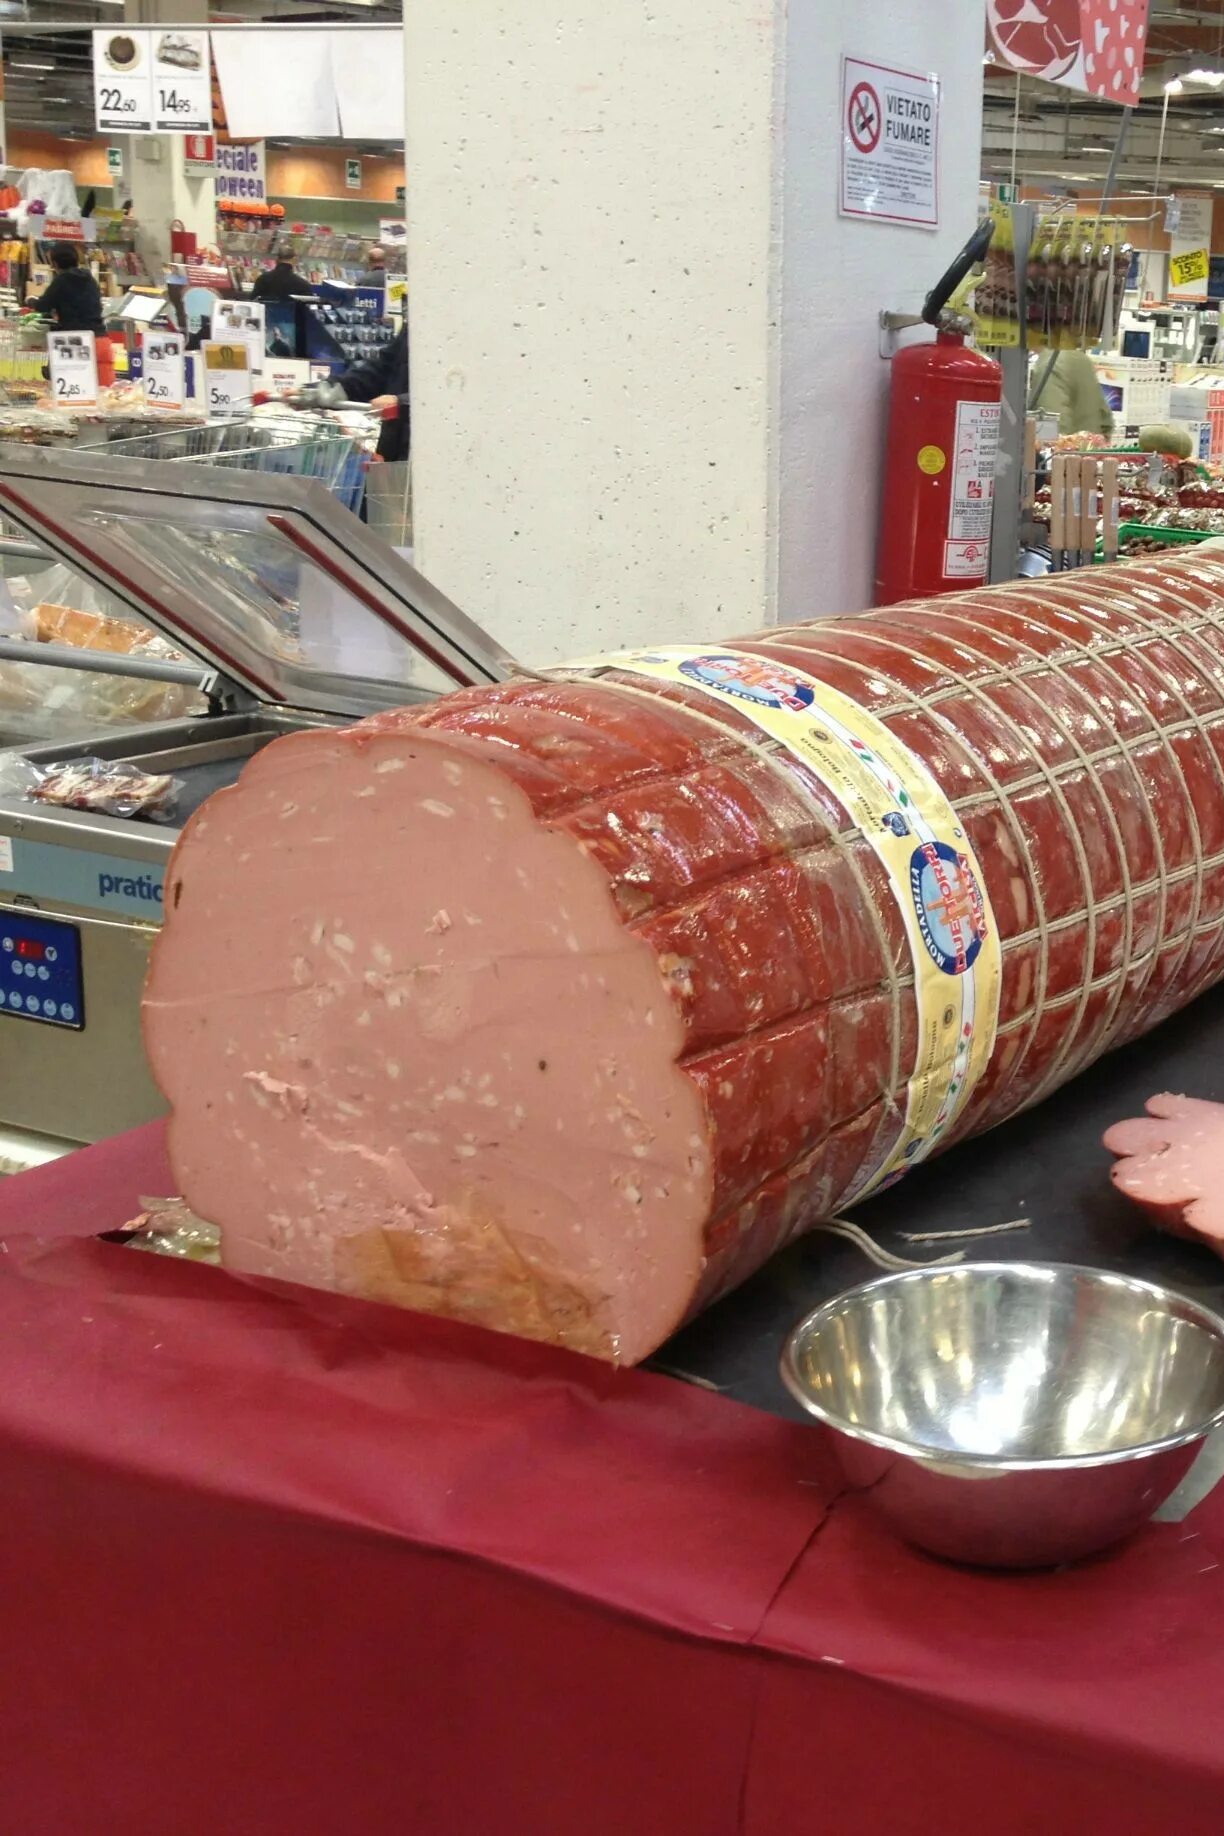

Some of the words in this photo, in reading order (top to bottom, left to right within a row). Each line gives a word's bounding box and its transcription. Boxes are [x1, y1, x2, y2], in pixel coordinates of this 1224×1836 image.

[886, 94, 931, 122] VIETATO
[886, 119, 931, 146] FUMARE
[98, 872, 163, 903] pratic
[911, 867, 946, 967] MORTADELLA
[948, 919, 967, 973] DUE
